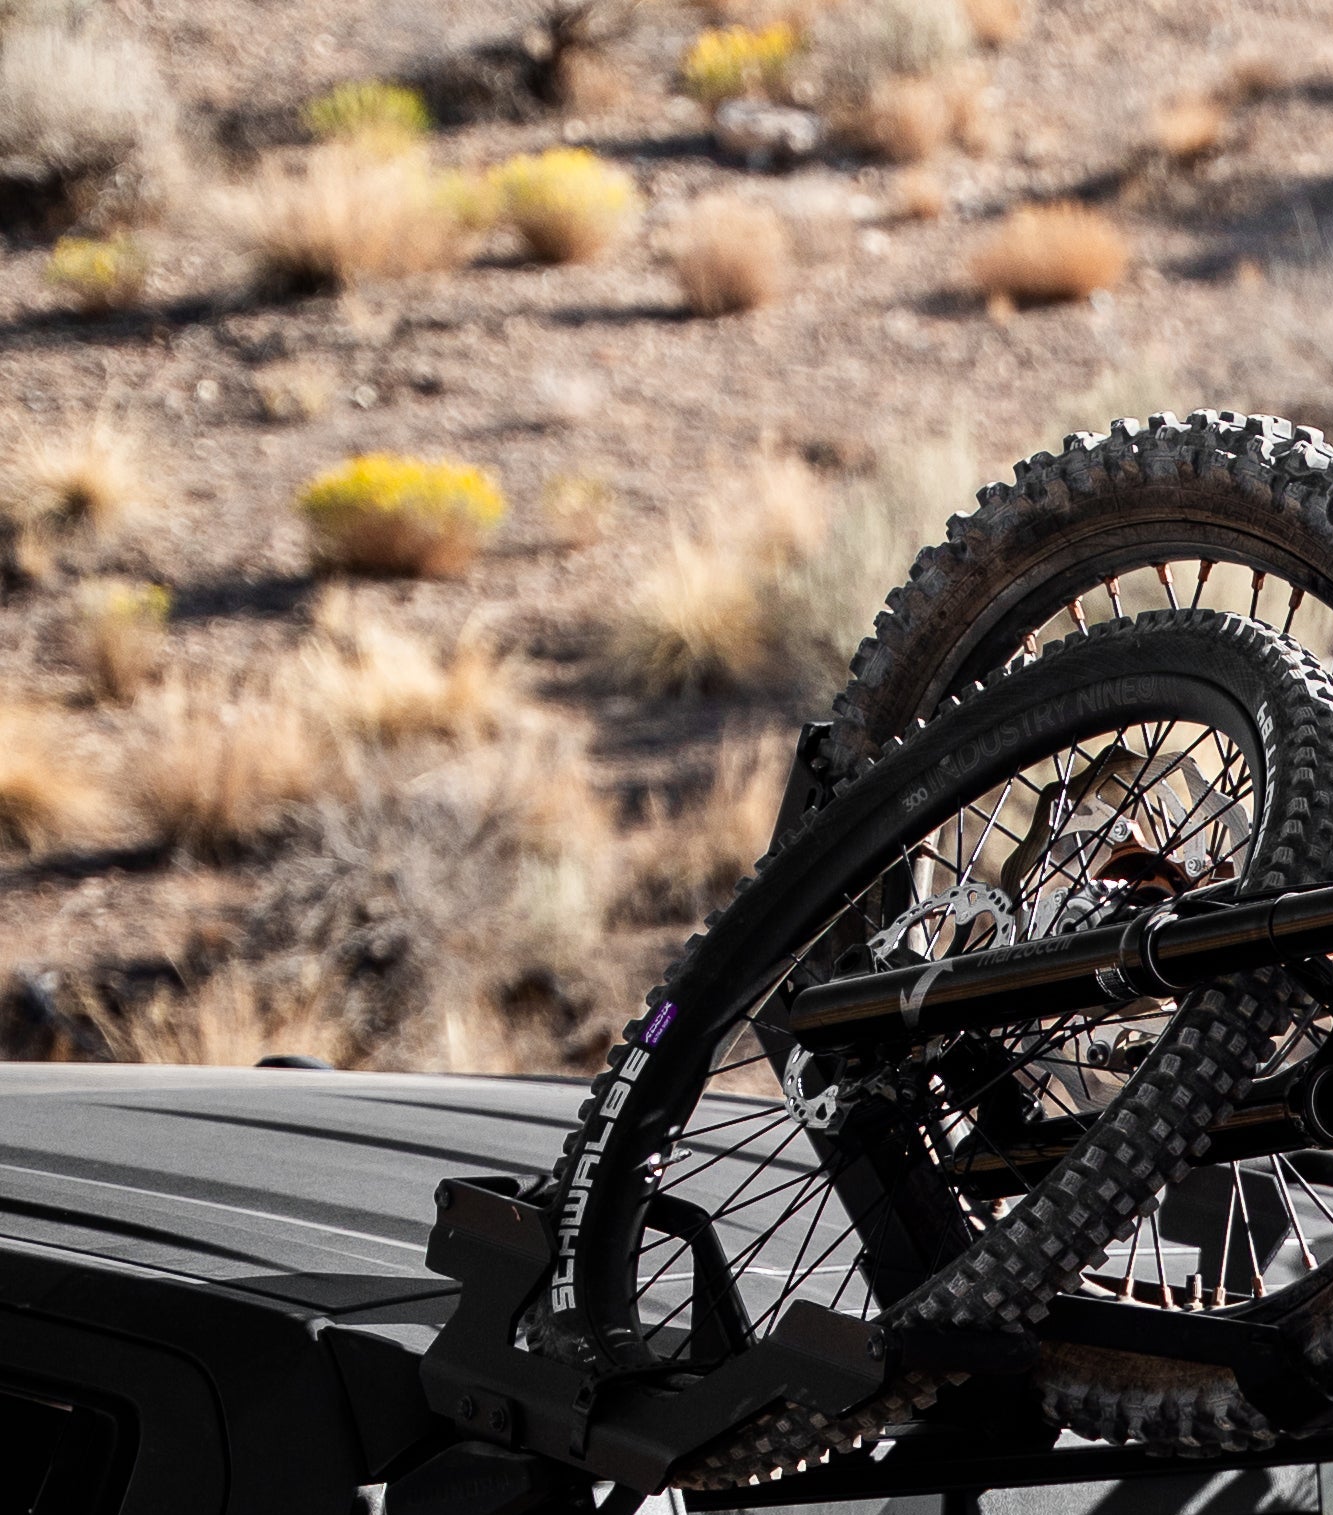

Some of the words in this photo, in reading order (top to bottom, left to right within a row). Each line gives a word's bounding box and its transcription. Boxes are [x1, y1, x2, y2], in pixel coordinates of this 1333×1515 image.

[926, 696, 1074, 796] INDUSTRY
[1076, 676, 1146, 715] NINE
[551, 1046, 650, 1314] SCHWALBE
